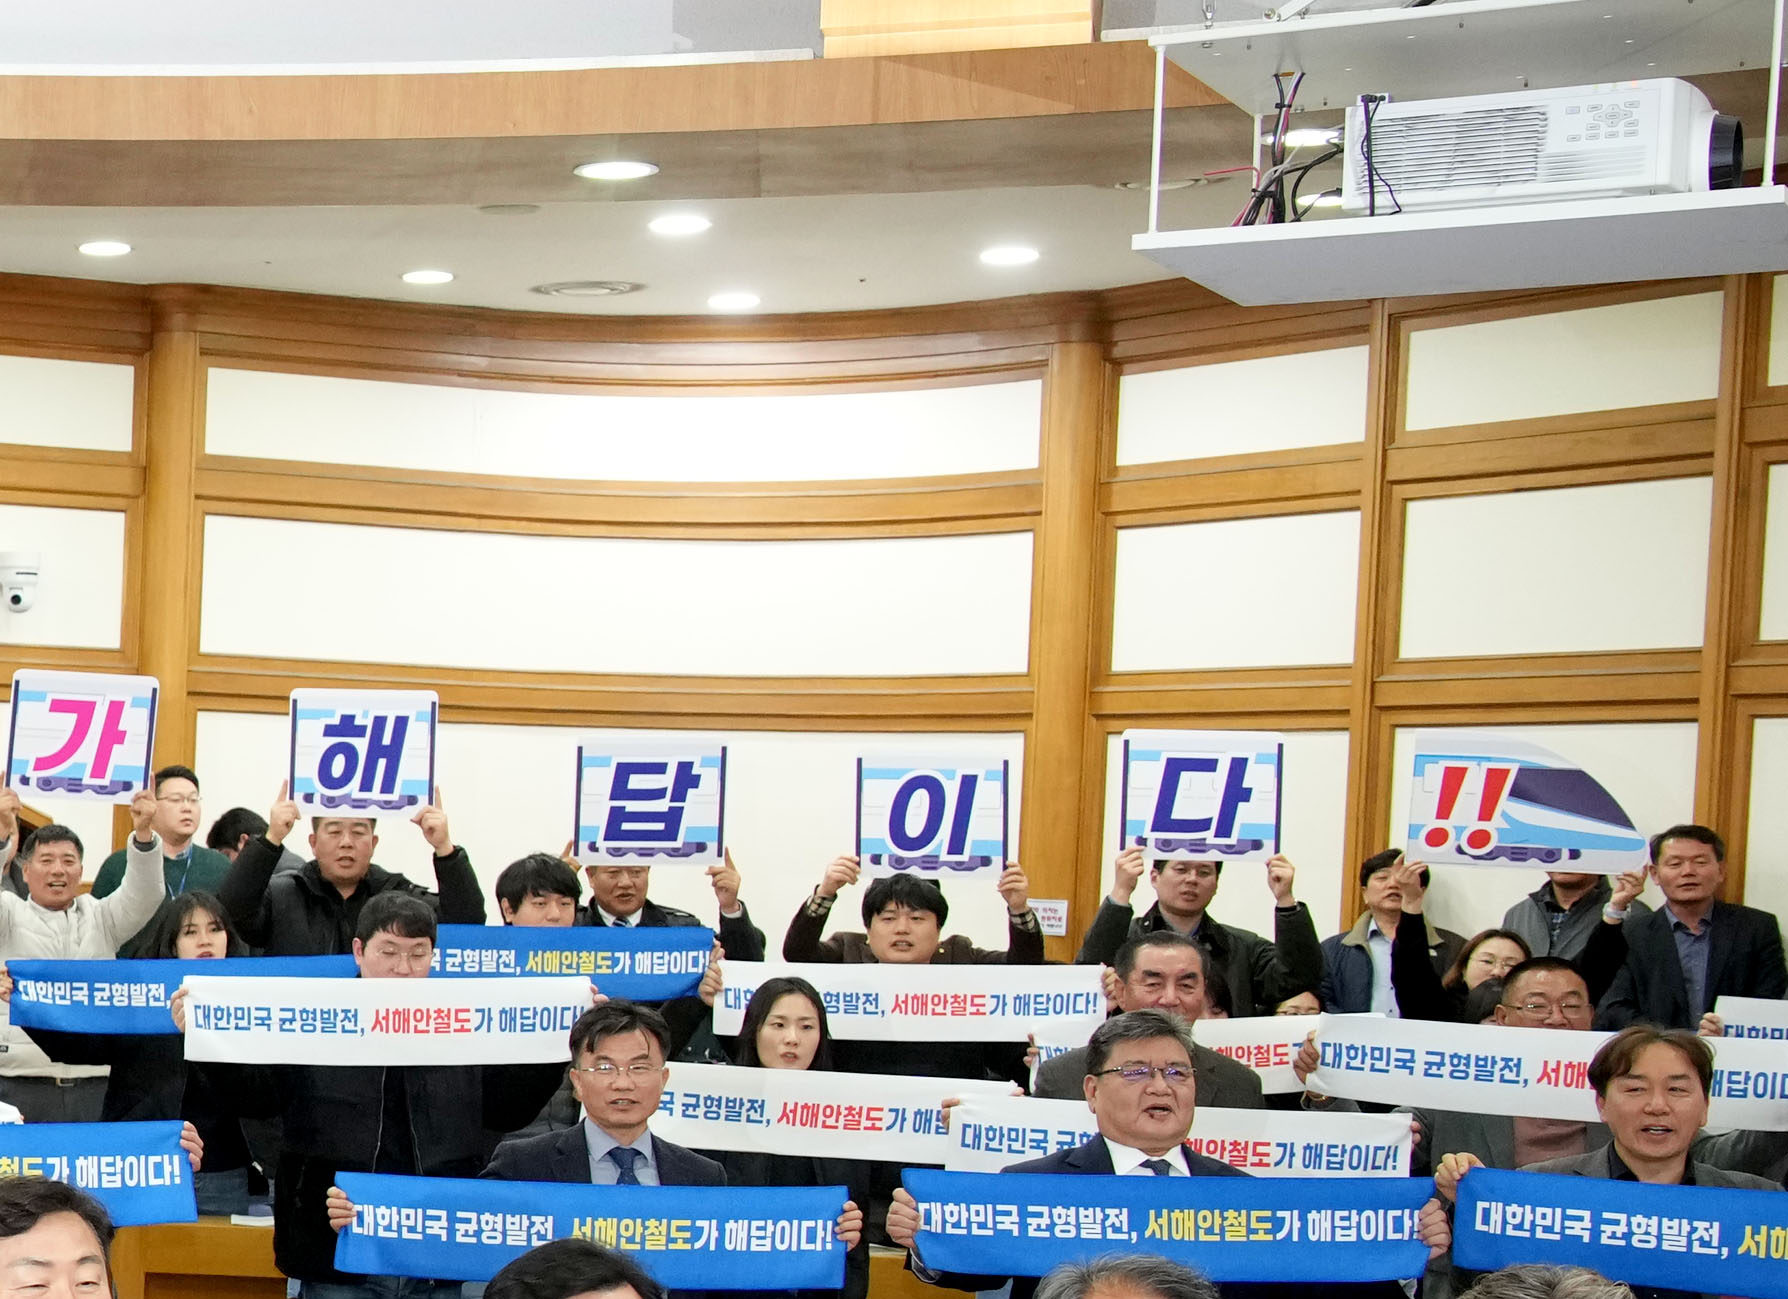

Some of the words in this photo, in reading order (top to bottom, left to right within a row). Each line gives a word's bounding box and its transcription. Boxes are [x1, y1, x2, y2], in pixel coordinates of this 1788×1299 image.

[32, 699, 127, 780] 가
[319, 714, 409, 794] 해
[603, 761, 701, 843] 답
[889, 772, 976, 855] 이
[1151, 756, 1252, 838] 다
[1421, 765, 1512, 851] !!
[445, 948, 521, 976] 균형발전,
[525, 949, 631, 975] 서해안철도가
[635, 950, 709, 975] 해답이다!
[19, 980, 90, 1006] 대한민국
[93, 982, 171, 1009] 균형발전,
[891, 992, 1007, 1017] 서해안철도가
[1013, 993, 1097, 1015] 해답이다!
[194, 1004, 272, 1032] 대한민국
[279, 1006, 366, 1036] 균형발전,
[371, 1006, 494, 1034] 서해안철도가
[1320, 1041, 1416, 1076] 대한민국
[1423, 1051, 1528, 1088] 균형발전,
[681, 1093, 771, 1127] 균형발전,
[777, 1101, 906, 1133] 서해안철도가
[76, 1152, 181, 1187] 해답이다!
[960, 1123, 1049, 1156] 대한민국
[1303, 1142, 1398, 1172] 해답이다!
[352, 1202, 447, 1241] 대한민국
[725, 1220, 832, 1252] 해답이다!
[918, 1202, 1019, 1236] 대한민국
[1026, 1205, 1138, 1243] 균형발전,
[1145, 1209, 1300, 1243] 서해안철도가
[1475, 1201, 1592, 1243] 대한민국
[1600, 1213, 1729, 1259] 균형발전,
